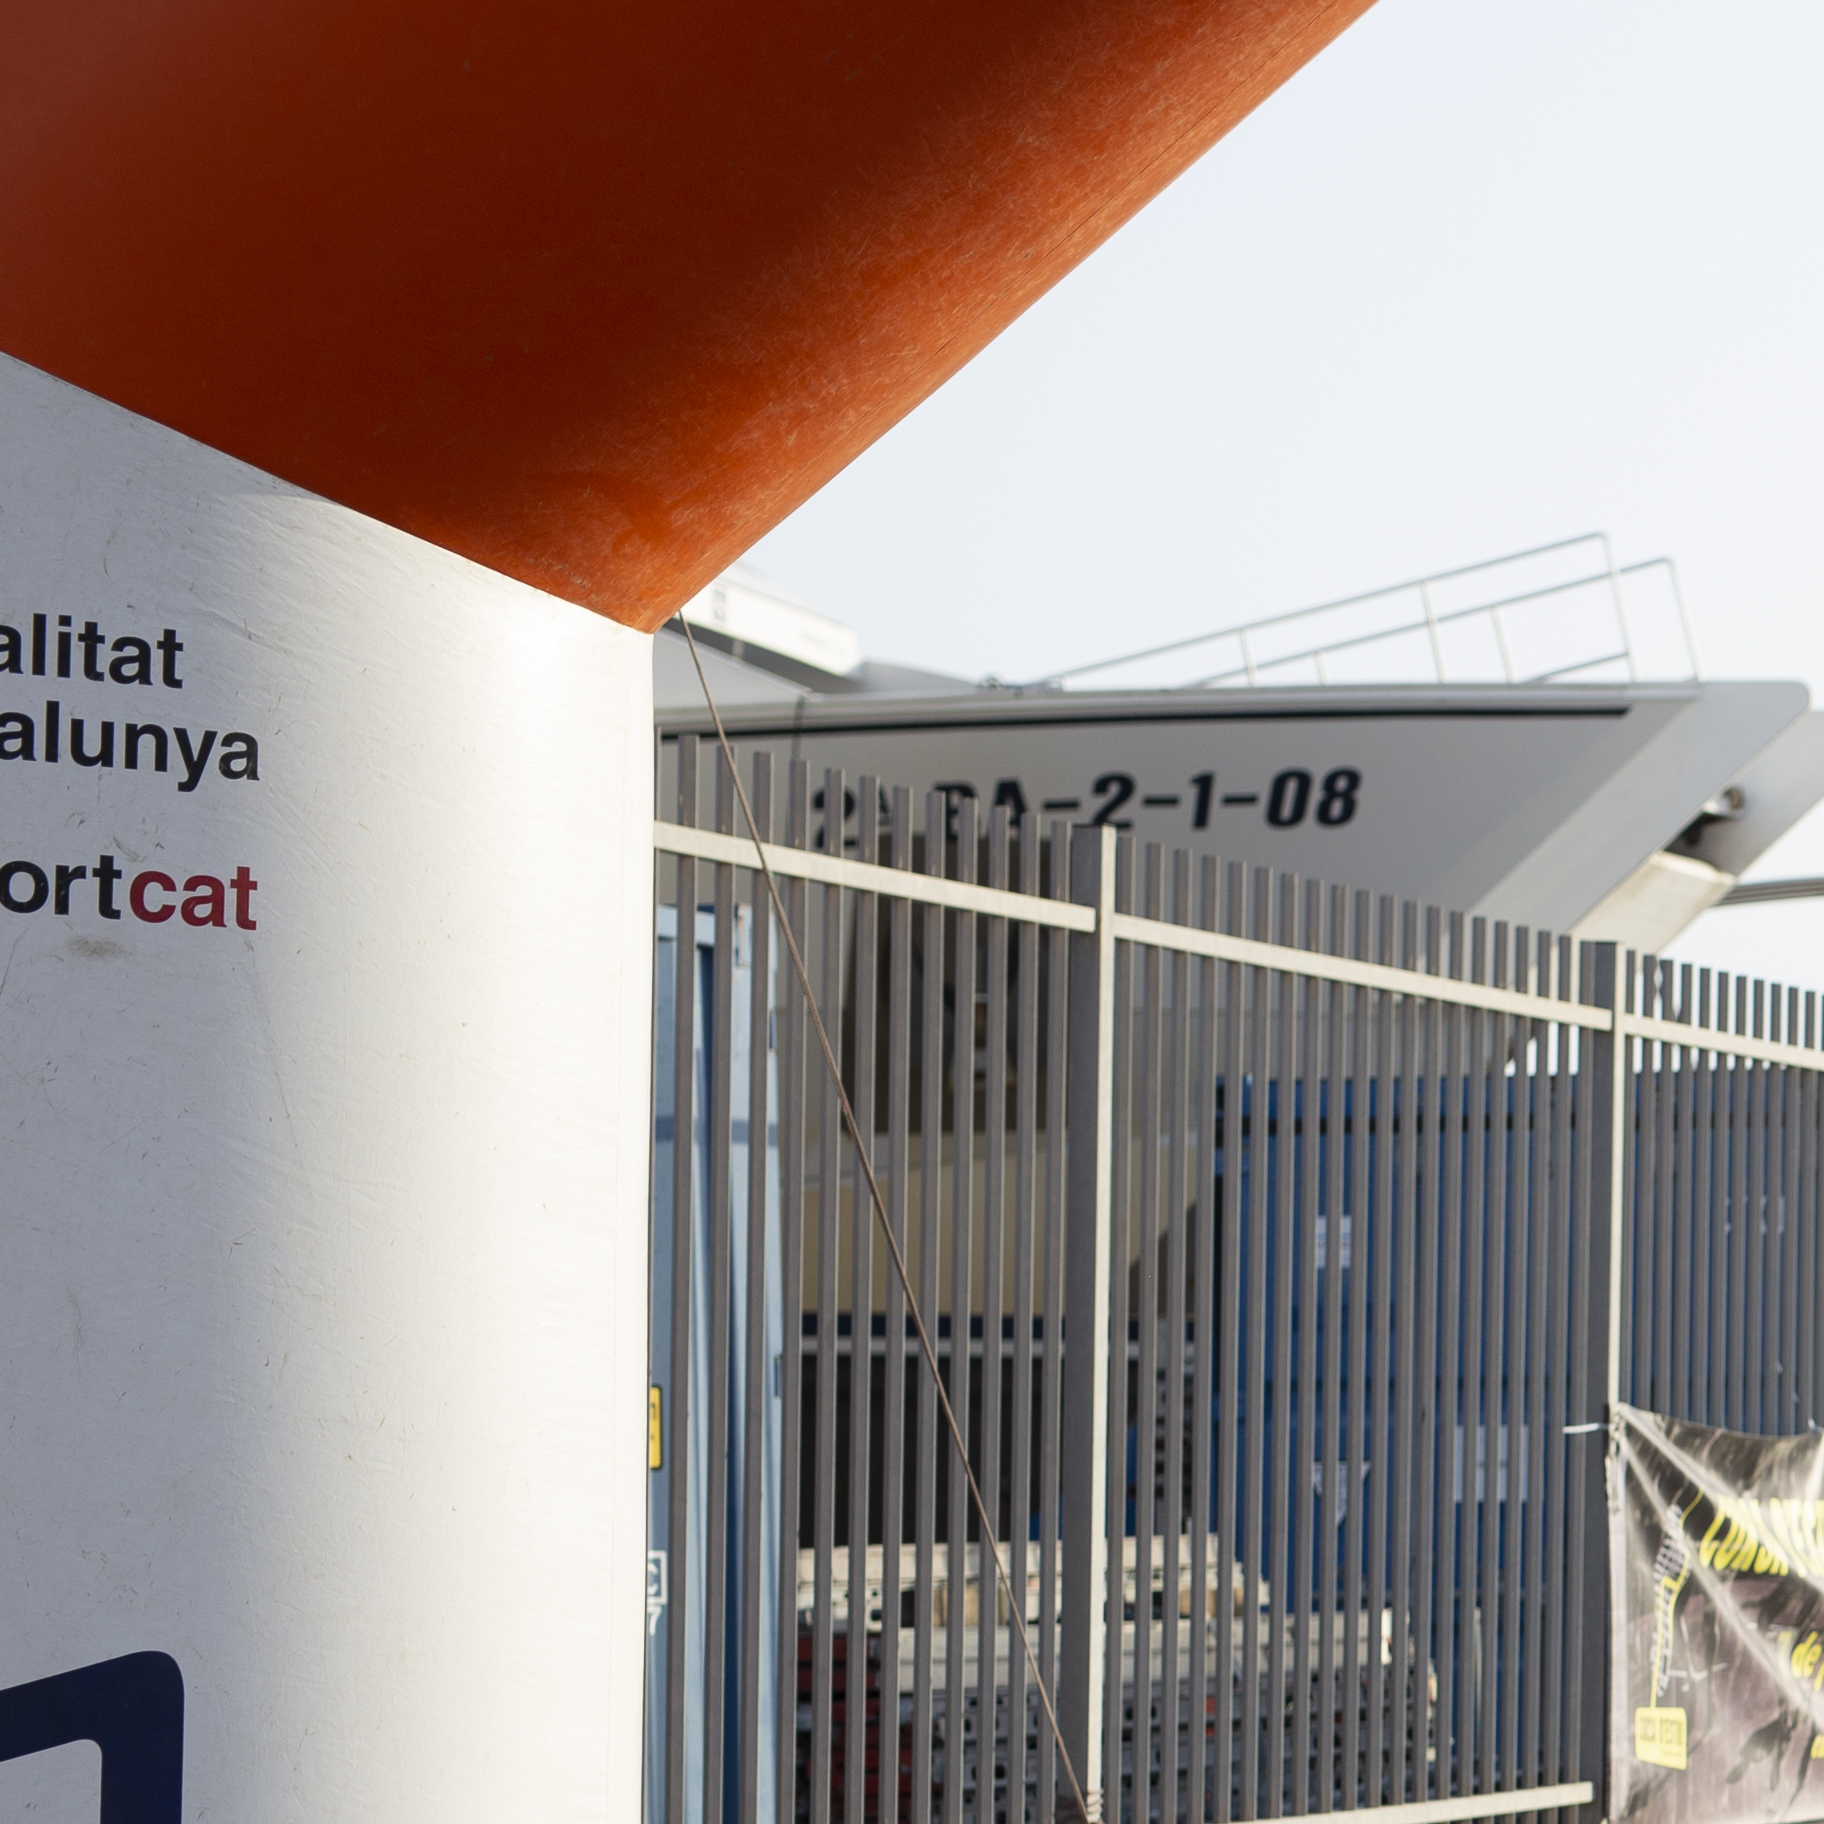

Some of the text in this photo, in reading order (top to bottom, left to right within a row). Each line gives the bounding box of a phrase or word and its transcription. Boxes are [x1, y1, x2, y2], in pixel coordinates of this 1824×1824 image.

[0, 699, 260, 793] alunya
[0, 854, 259, 931] ortcat
[1790, 1630, 1822, 1679] de
